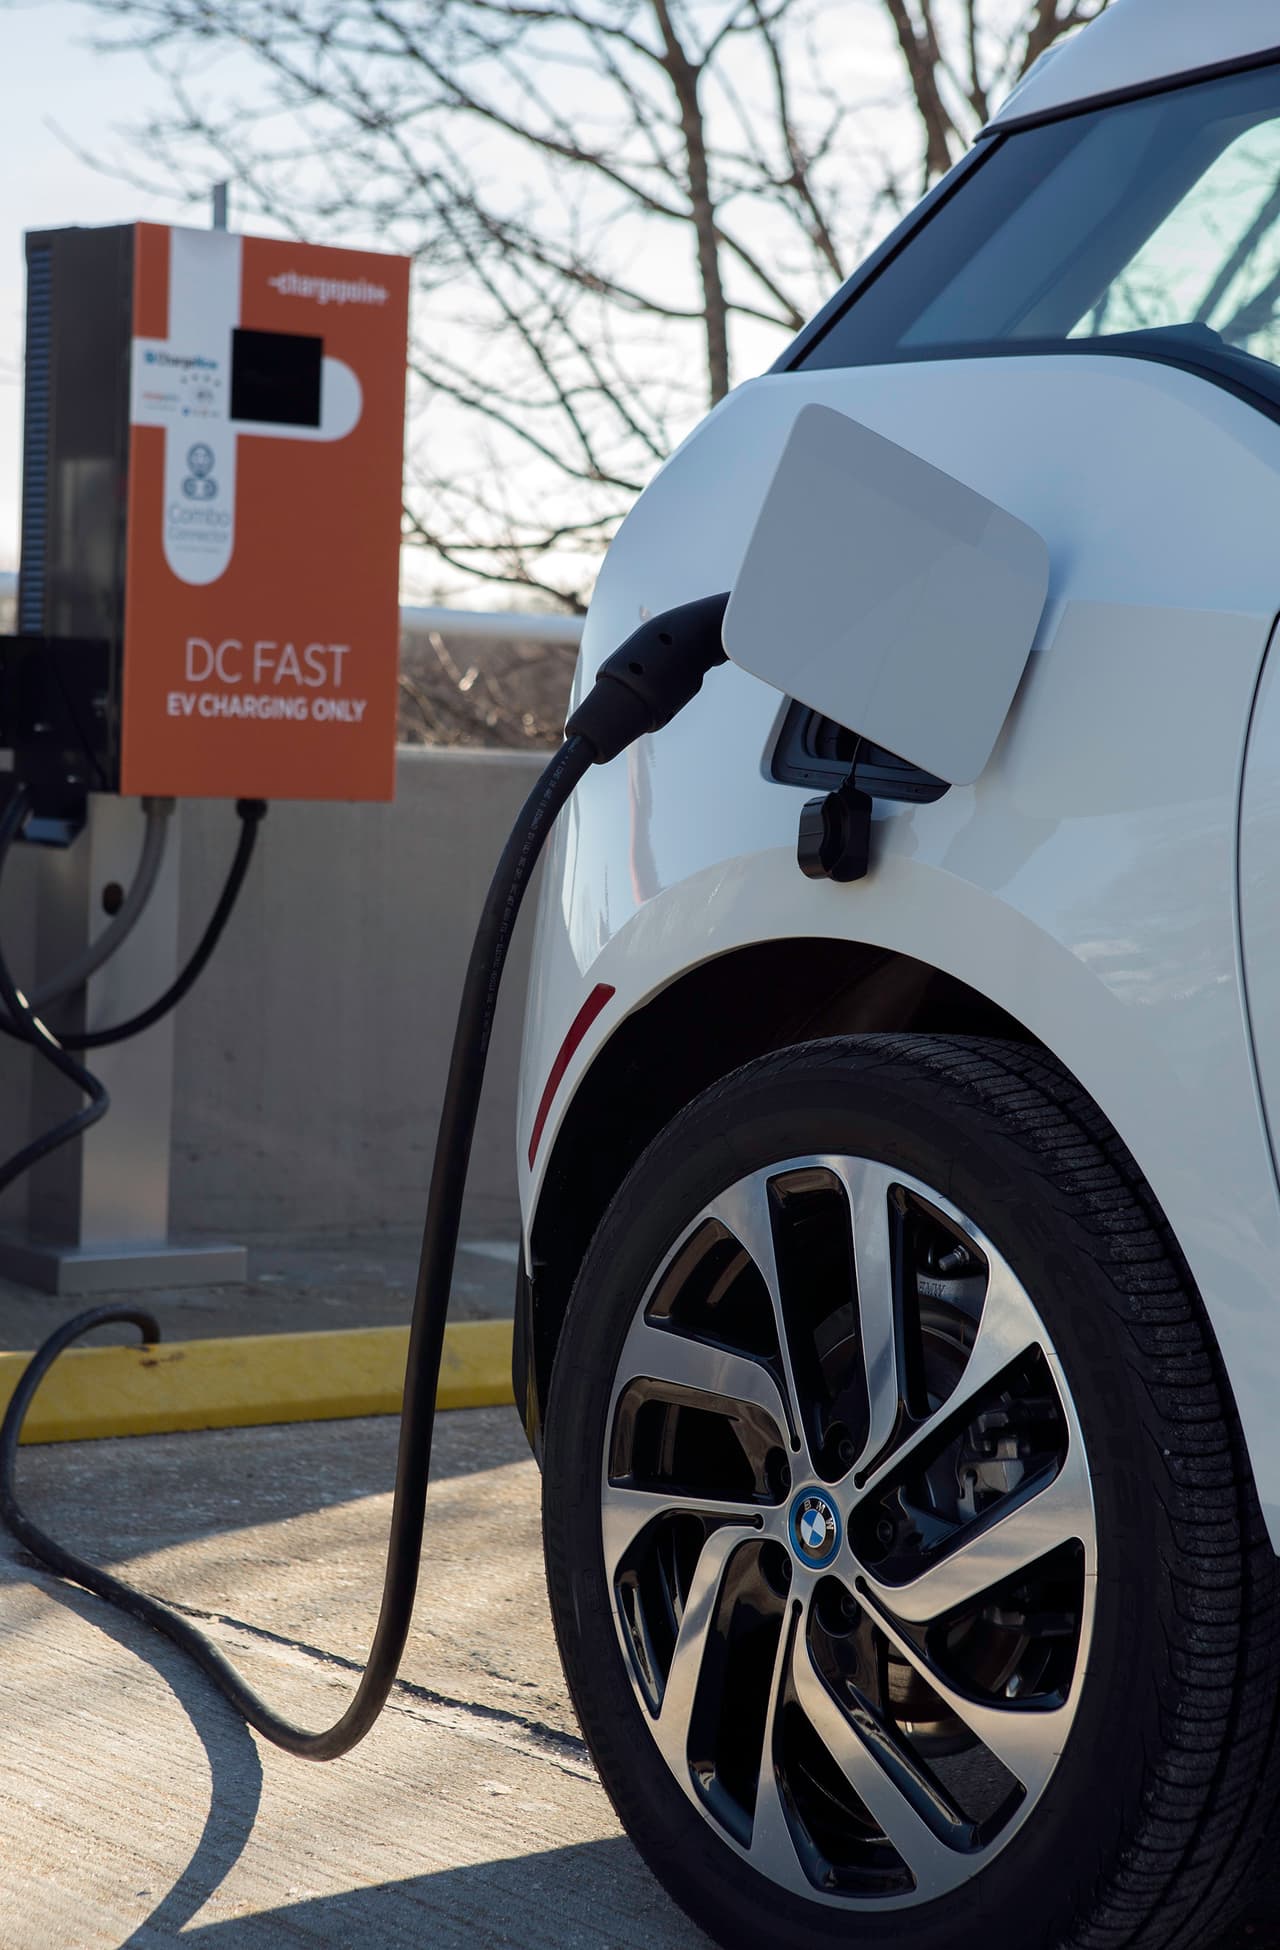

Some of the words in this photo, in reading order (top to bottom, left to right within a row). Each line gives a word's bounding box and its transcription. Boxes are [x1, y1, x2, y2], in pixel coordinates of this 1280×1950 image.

[186, 637, 242, 684] DC
[253, 640, 351, 687] FAST
[167, 691, 197, 716] EV
[200, 692, 309, 720] CHARGING
[312, 696, 368, 722] ONLY
[803, 1499, 835, 1530] BMW
